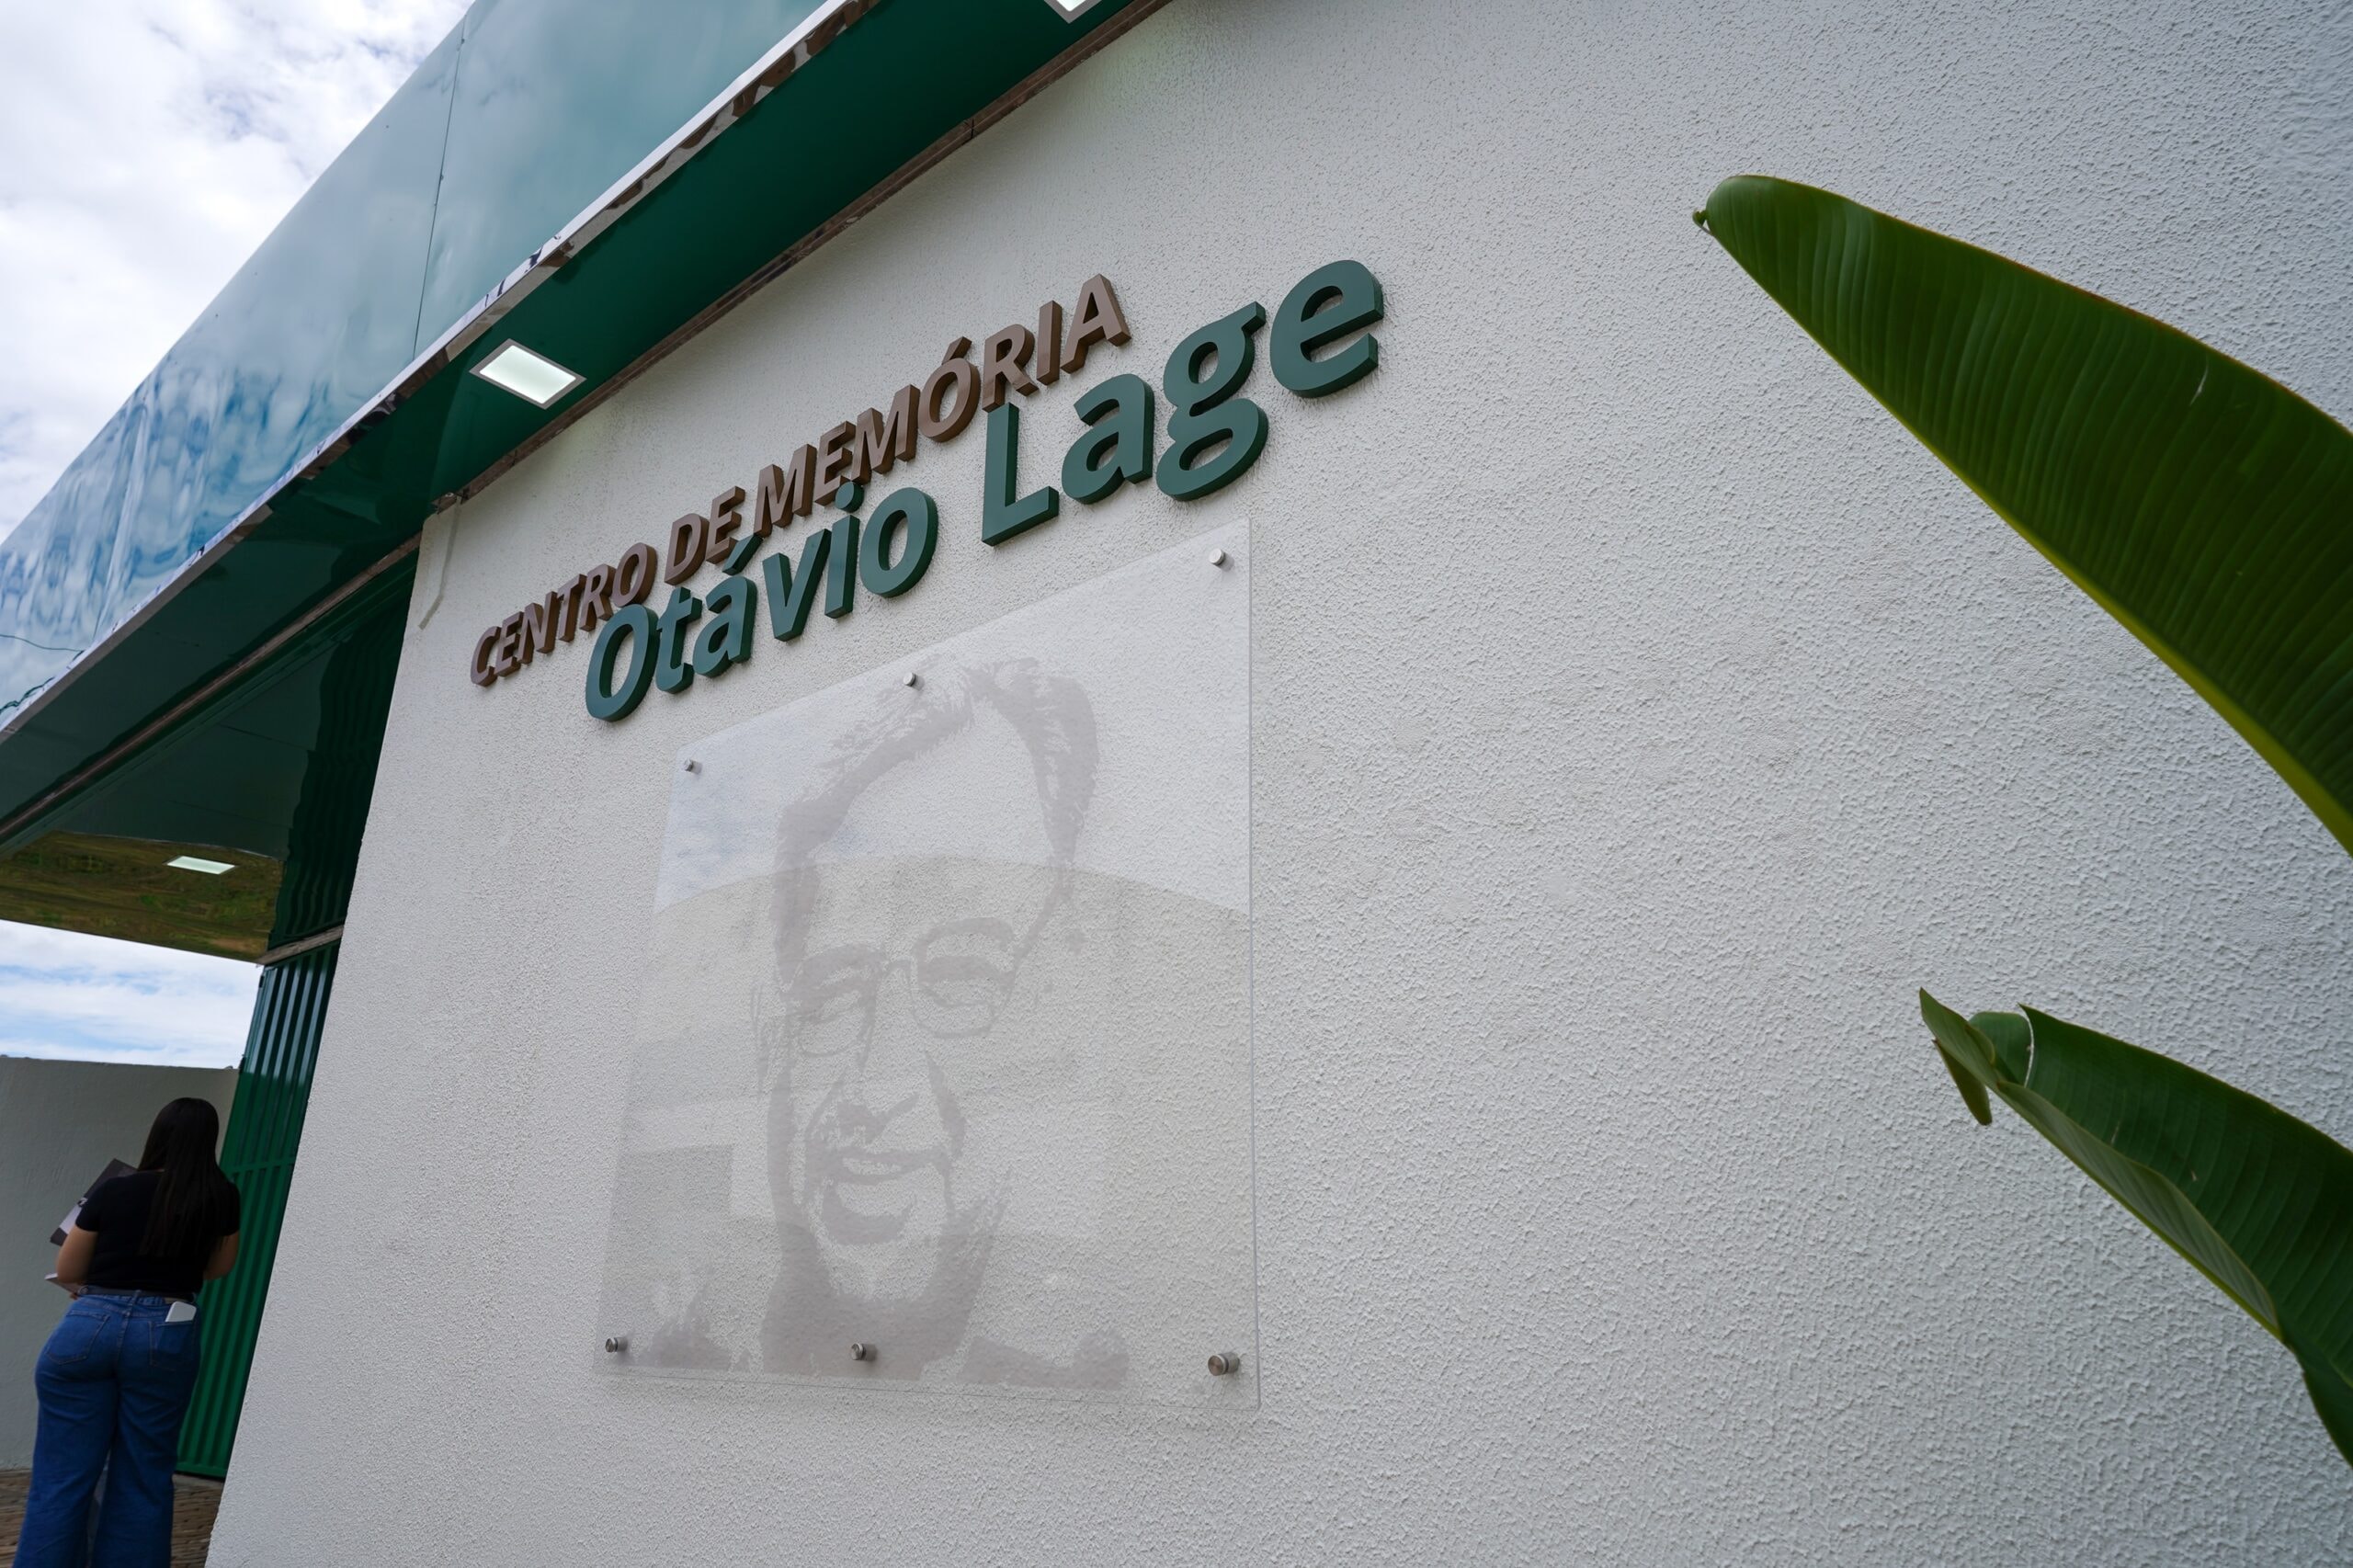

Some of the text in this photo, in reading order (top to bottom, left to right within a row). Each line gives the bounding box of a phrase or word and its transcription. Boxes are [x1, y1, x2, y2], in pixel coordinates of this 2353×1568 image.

[470, 273, 1131, 687] CENTRO DE MEMÓRIA
[585, 259, 1384, 722] Otávio Lage
